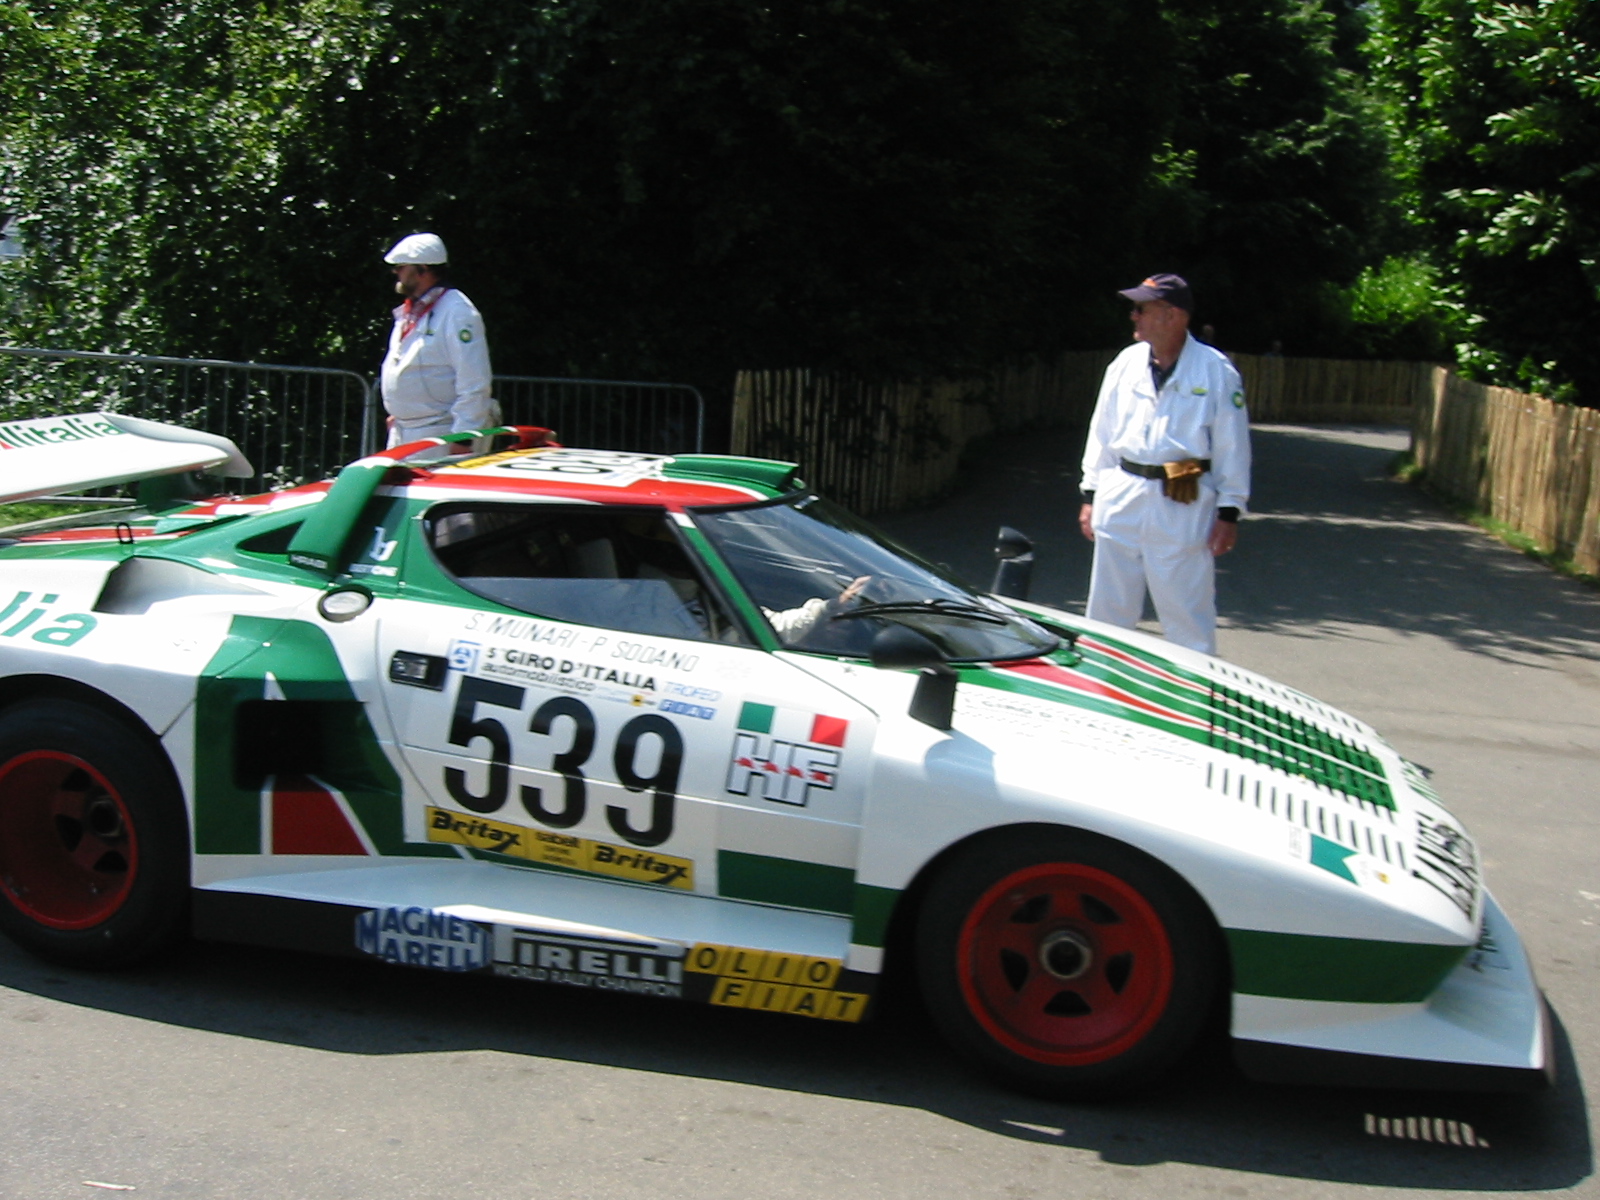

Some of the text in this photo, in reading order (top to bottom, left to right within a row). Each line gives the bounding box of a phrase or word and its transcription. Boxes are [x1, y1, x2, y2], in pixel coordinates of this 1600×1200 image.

[487, 616, 580, 649] MUNARI
[611, 640, 700, 673] SODANO
[505, 649, 555, 671] GIRO
[559, 660, 657, 692] D'ITALIA
[661, 700, 716, 719] FIAT
[444, 675, 684, 847] 539
[725, 733, 842, 807] HF
[432, 810, 521, 853] Britax
[594, 845, 688, 885] Britax
[358, 907, 490, 948] MAGNETI
[493, 924, 687, 984] PIRELLI
[696, 947, 831, 983] OLIO
[493, 962, 683, 998] WORLD RALLY CHAMPION
[720, 983, 857, 1019] FIAT
